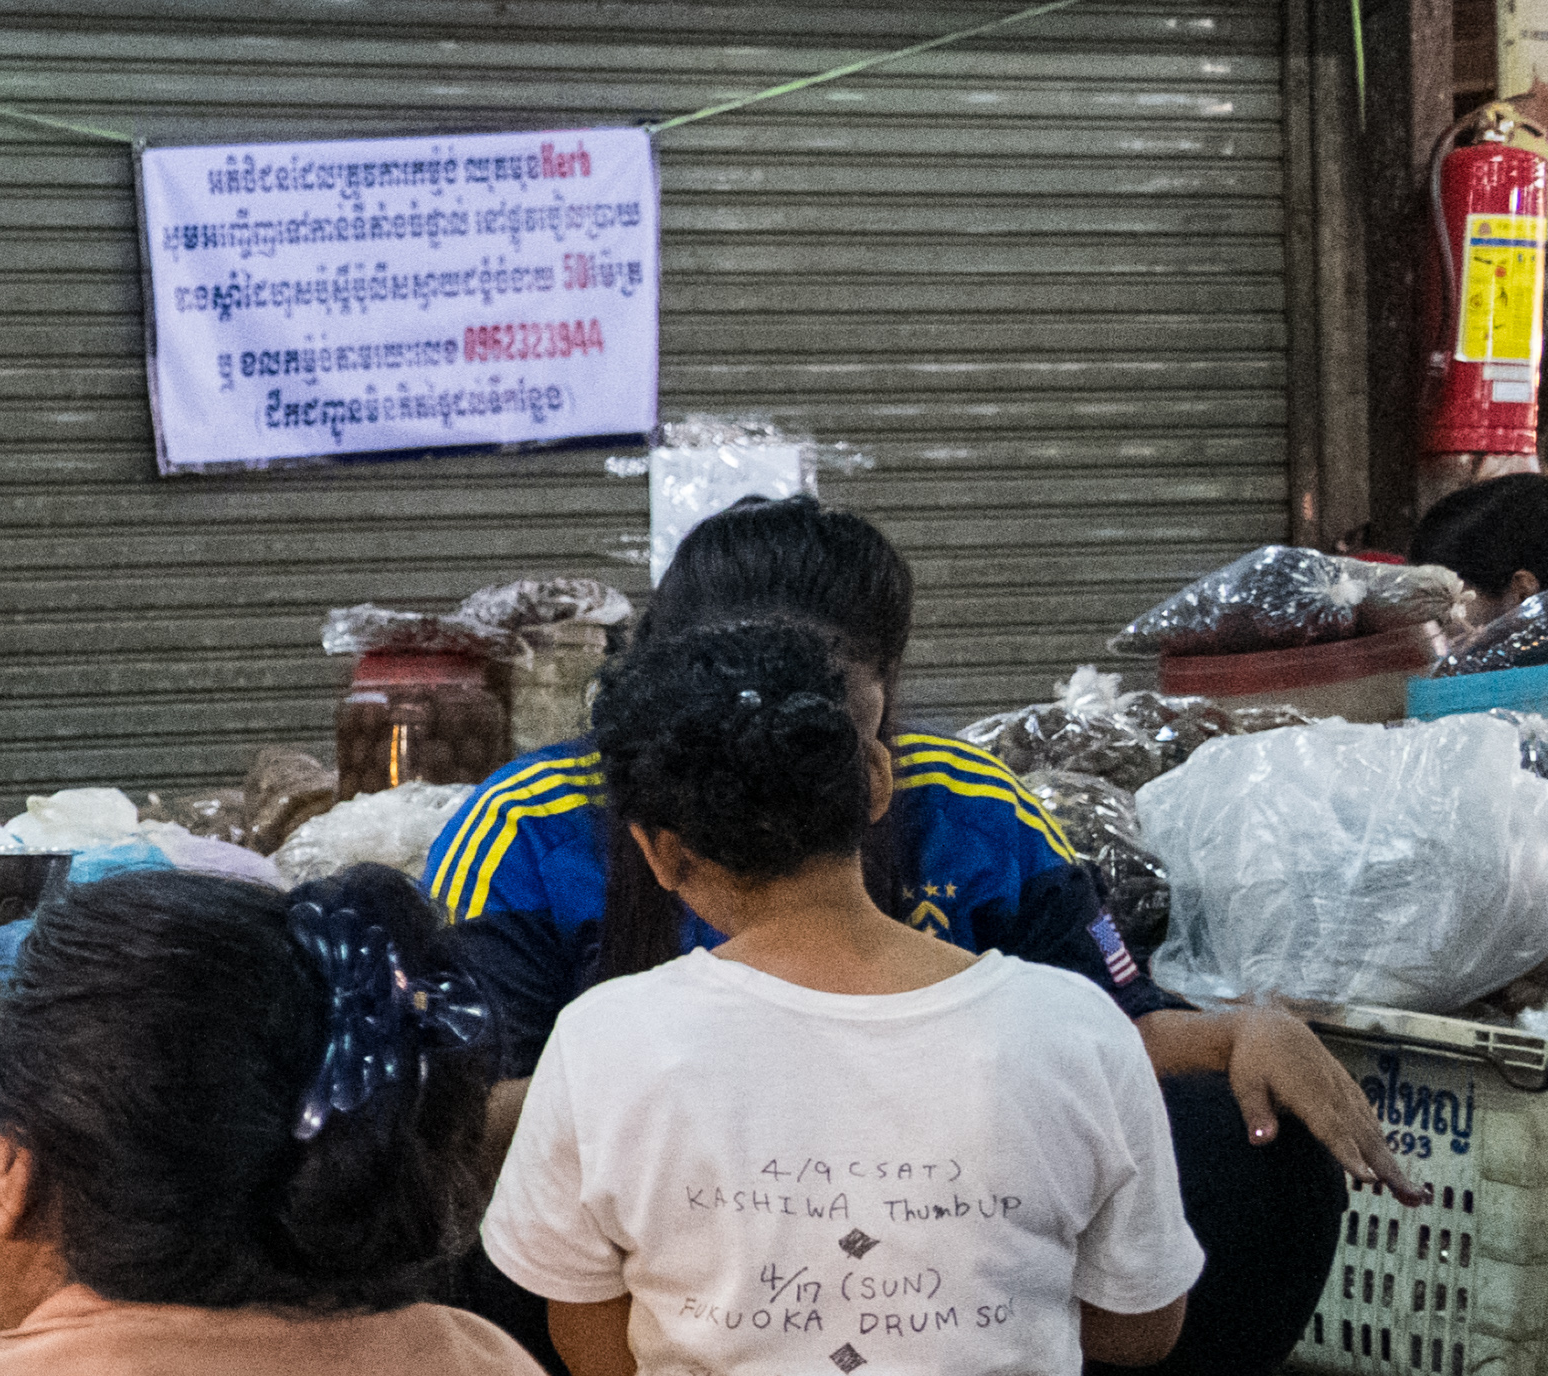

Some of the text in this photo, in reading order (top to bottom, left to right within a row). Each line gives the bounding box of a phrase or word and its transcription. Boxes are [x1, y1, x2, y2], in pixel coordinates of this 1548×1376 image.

[1385, 1129, 1433, 1160] 693
[760, 1157, 963, 1183] 4/9 (SAT)
[685, 1186, 849, 1220] KASHIWA
[760, 1262, 943, 1304] 4/17 (SUN)
[679, 1296, 824, 1333] FUKUOKA
[859, 1305, 959, 1337] DRUM
